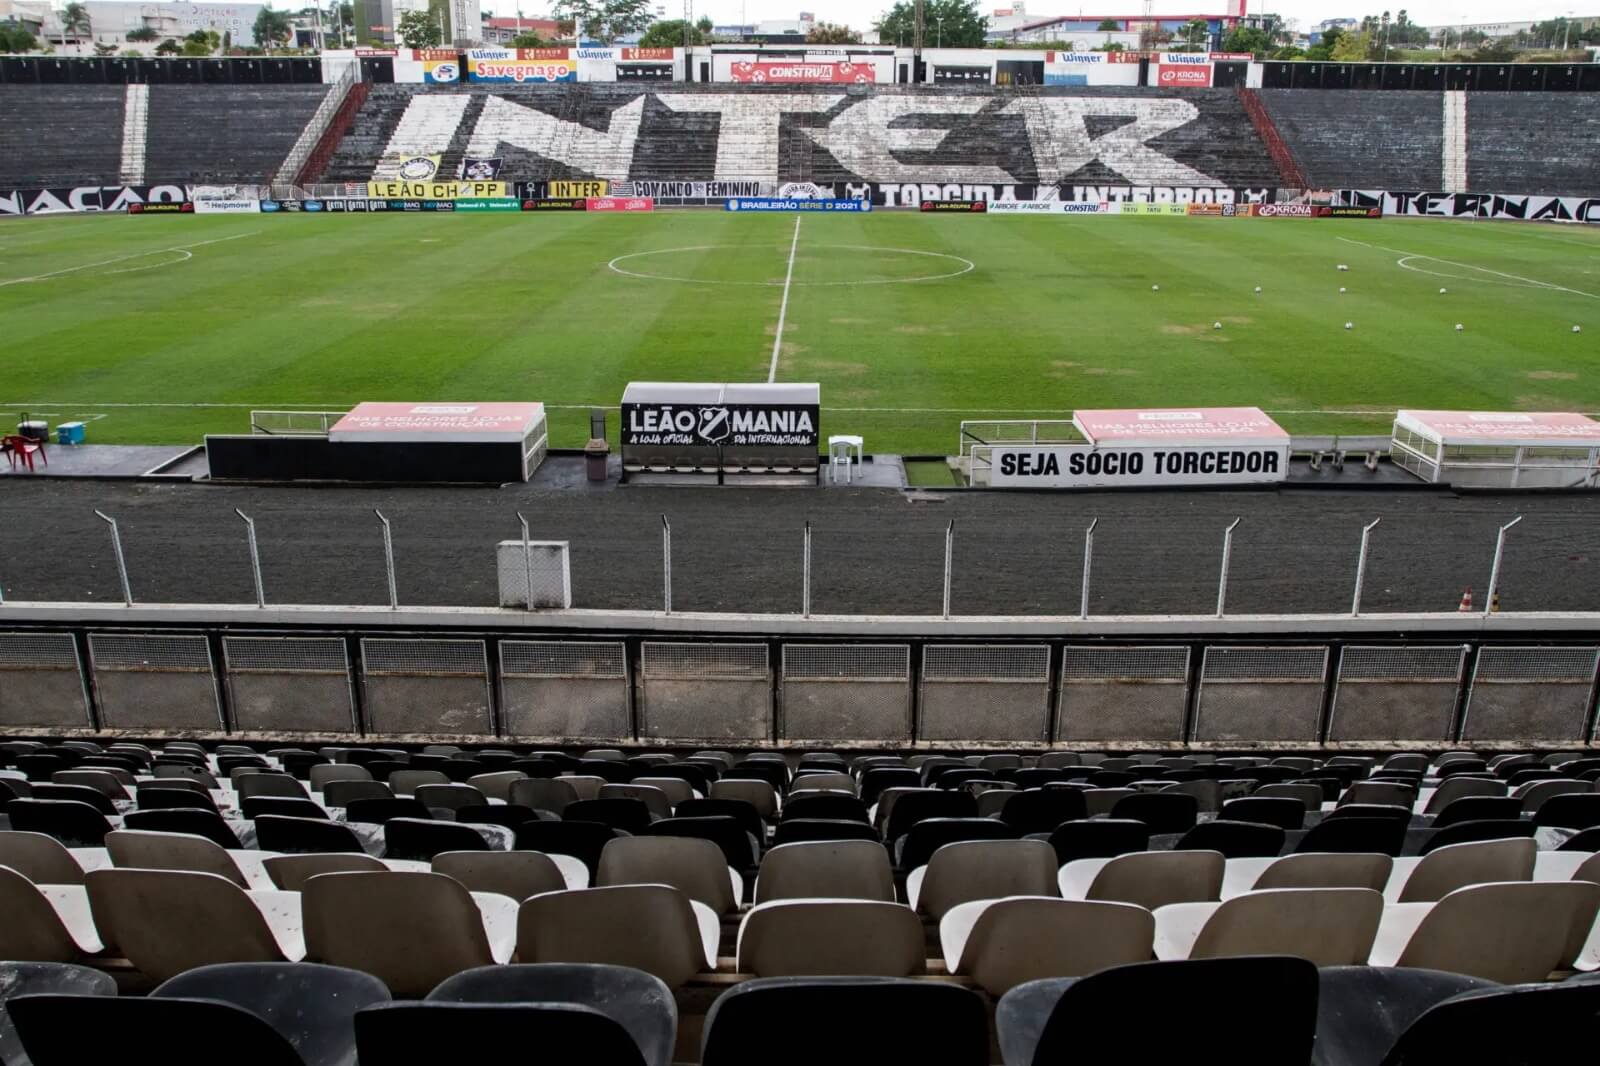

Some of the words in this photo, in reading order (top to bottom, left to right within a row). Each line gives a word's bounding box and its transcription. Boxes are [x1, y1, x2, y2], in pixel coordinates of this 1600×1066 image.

[471, 49, 510, 60] Winner
[576, 49, 614, 60] Winner
[1062, 53, 1102, 64] Winner
[1168, 54, 1206, 64] Winner
[476, 62, 569, 81] Savegnago
[1177, 71, 1206, 79] KRONA
[372, 93, 1230, 186] INTER
[556, 182, 602, 197] INTER
[634, 182, 693, 197] COMANDO
[706, 182, 760, 197] FEMININO
[741, 200, 797, 210] BRASILEIRÃO
[1276, 204, 1311, 214] KRONA
[630, 406, 696, 432] LEÃO
[732, 410, 813, 433] MANIA
[629, 434, 638, 443] A
[640, 434, 661, 444] LOJA
[663, 433, 694, 443] OFICIAL
[734, 434, 747, 443] DA
[748, 434, 811, 444] INTERNACIONAL
[1001, 453, 1059, 475] SEJA
[1069, 448, 1144, 474] SÓCIO
[1153, 451, 1279, 474] TORCEDOR
